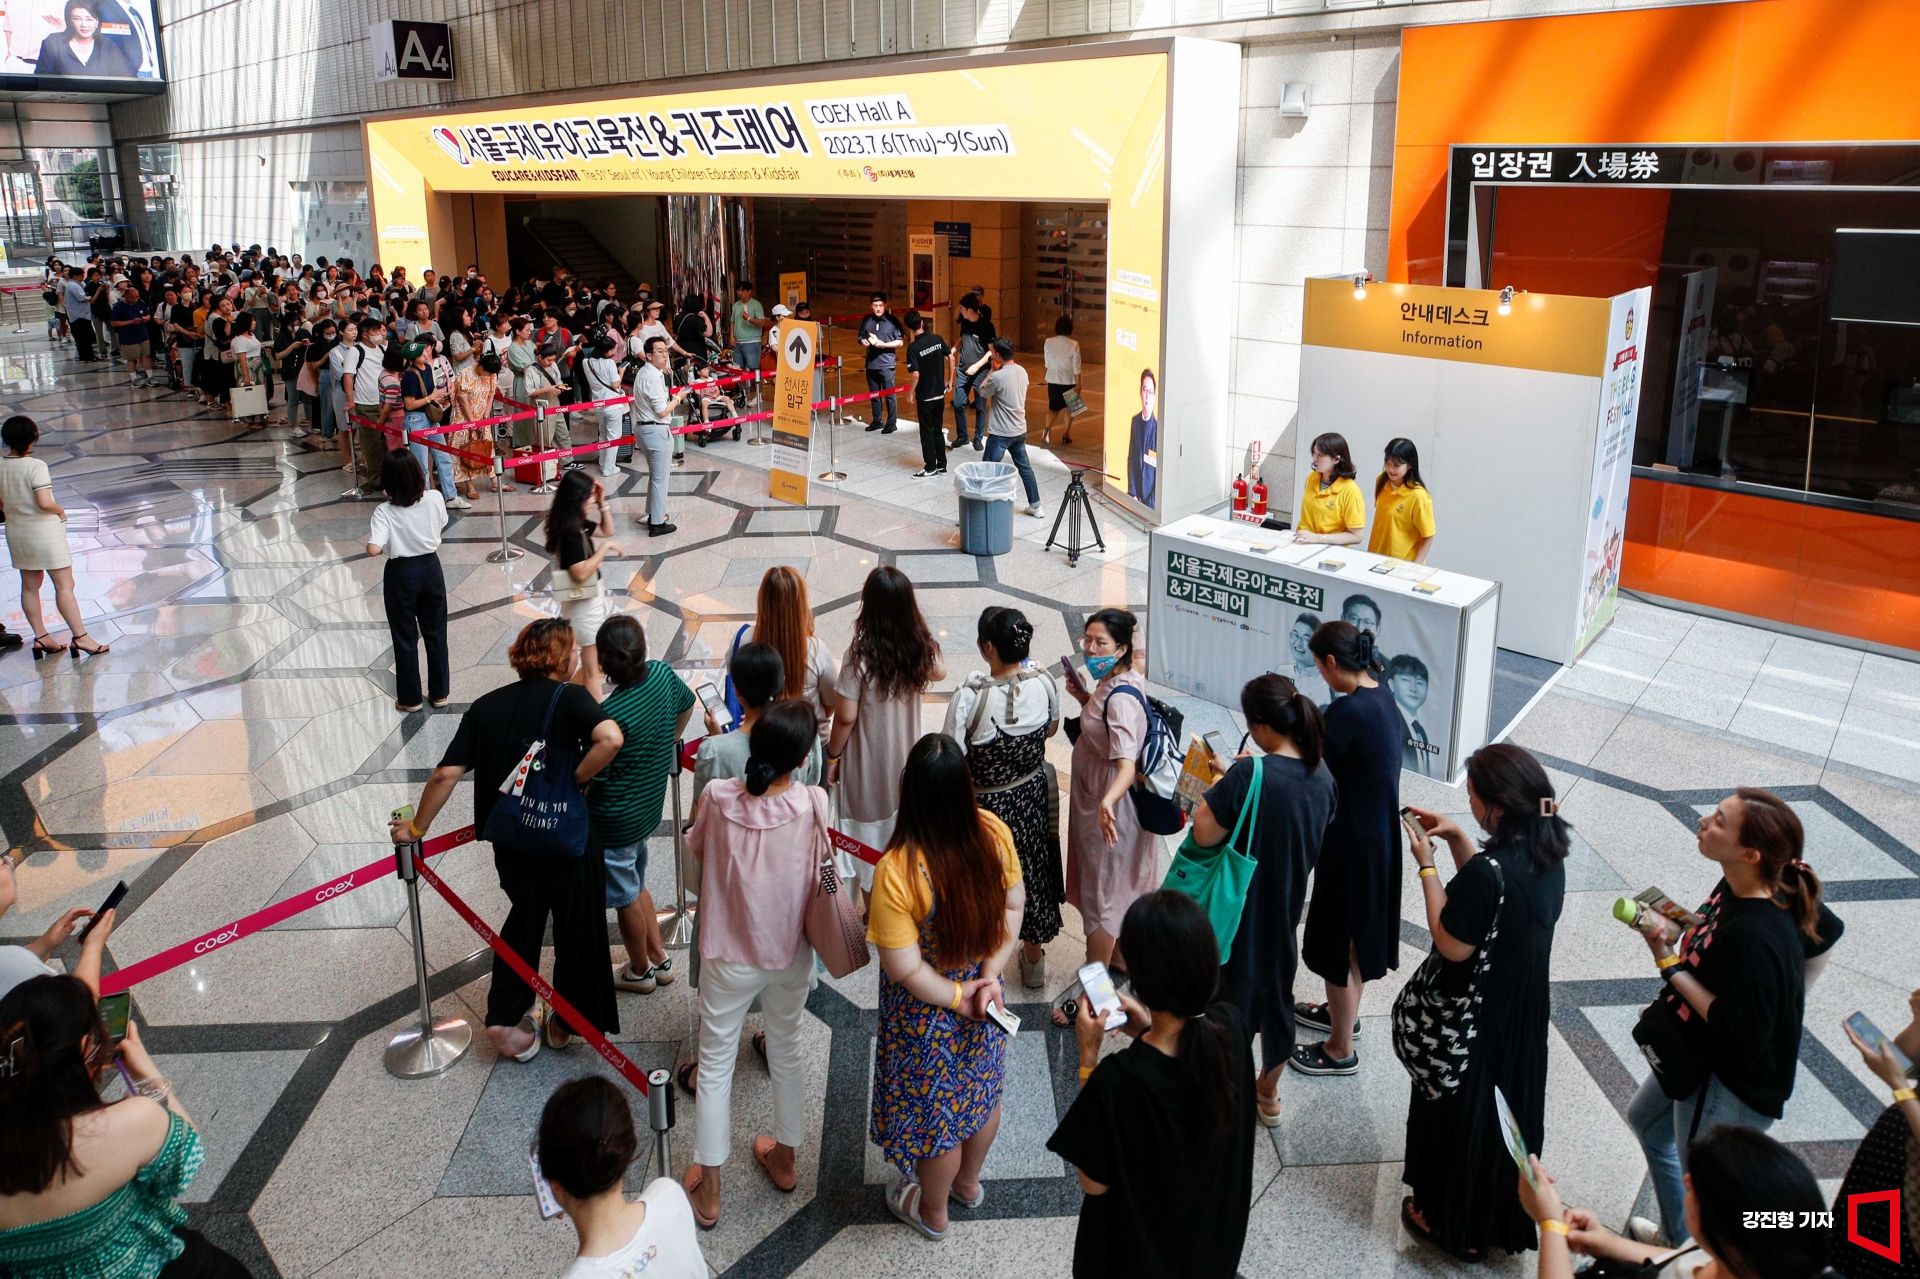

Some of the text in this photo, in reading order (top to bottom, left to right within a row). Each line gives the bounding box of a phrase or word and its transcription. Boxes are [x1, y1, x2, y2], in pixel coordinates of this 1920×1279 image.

[400, 30, 449, 71] A4
[810, 100, 911, 124] COEX Hall A
[459, 106, 809, 162] 서울국제유아교육전&키즈페어
[824, 129, 1009, 156] 2023.7.6(Thu)~9(Sun)
[492, 169, 581, 181] EDUCARE&KIDSFAIR
[671, 167, 707, 181] Children
[706, 167, 753, 181] Education
[752, 167, 762, 180] &
[761, 166, 800, 180] Kidsfair
[1471, 151, 1660, 180] 입장권 入場券
[1400, 302, 1490, 327] 안내데스크
[919, 343, 942, 358] SECURITY
[1402, 330, 1483, 350] Information
[783, 376, 809, 395] 전시장
[787, 394, 804, 410] 입구
[1170, 552, 1320, 609] 서울국제유아교육전
[1169, 579, 1245, 616] &키즈페어
[537, 801, 548, 813] ARE
[552, 801, 568, 813] YOU
[521, 812, 559, 830] FEELING?
[835, 836, 861, 856] coex
[315, 874, 354, 902] coex
[422, 867, 439, 888] coex
[194, 923, 238, 954] coex
[473, 920, 493, 944] coex
[531, 976, 553, 1004] coex
[601, 1043, 626, 1074] coex
